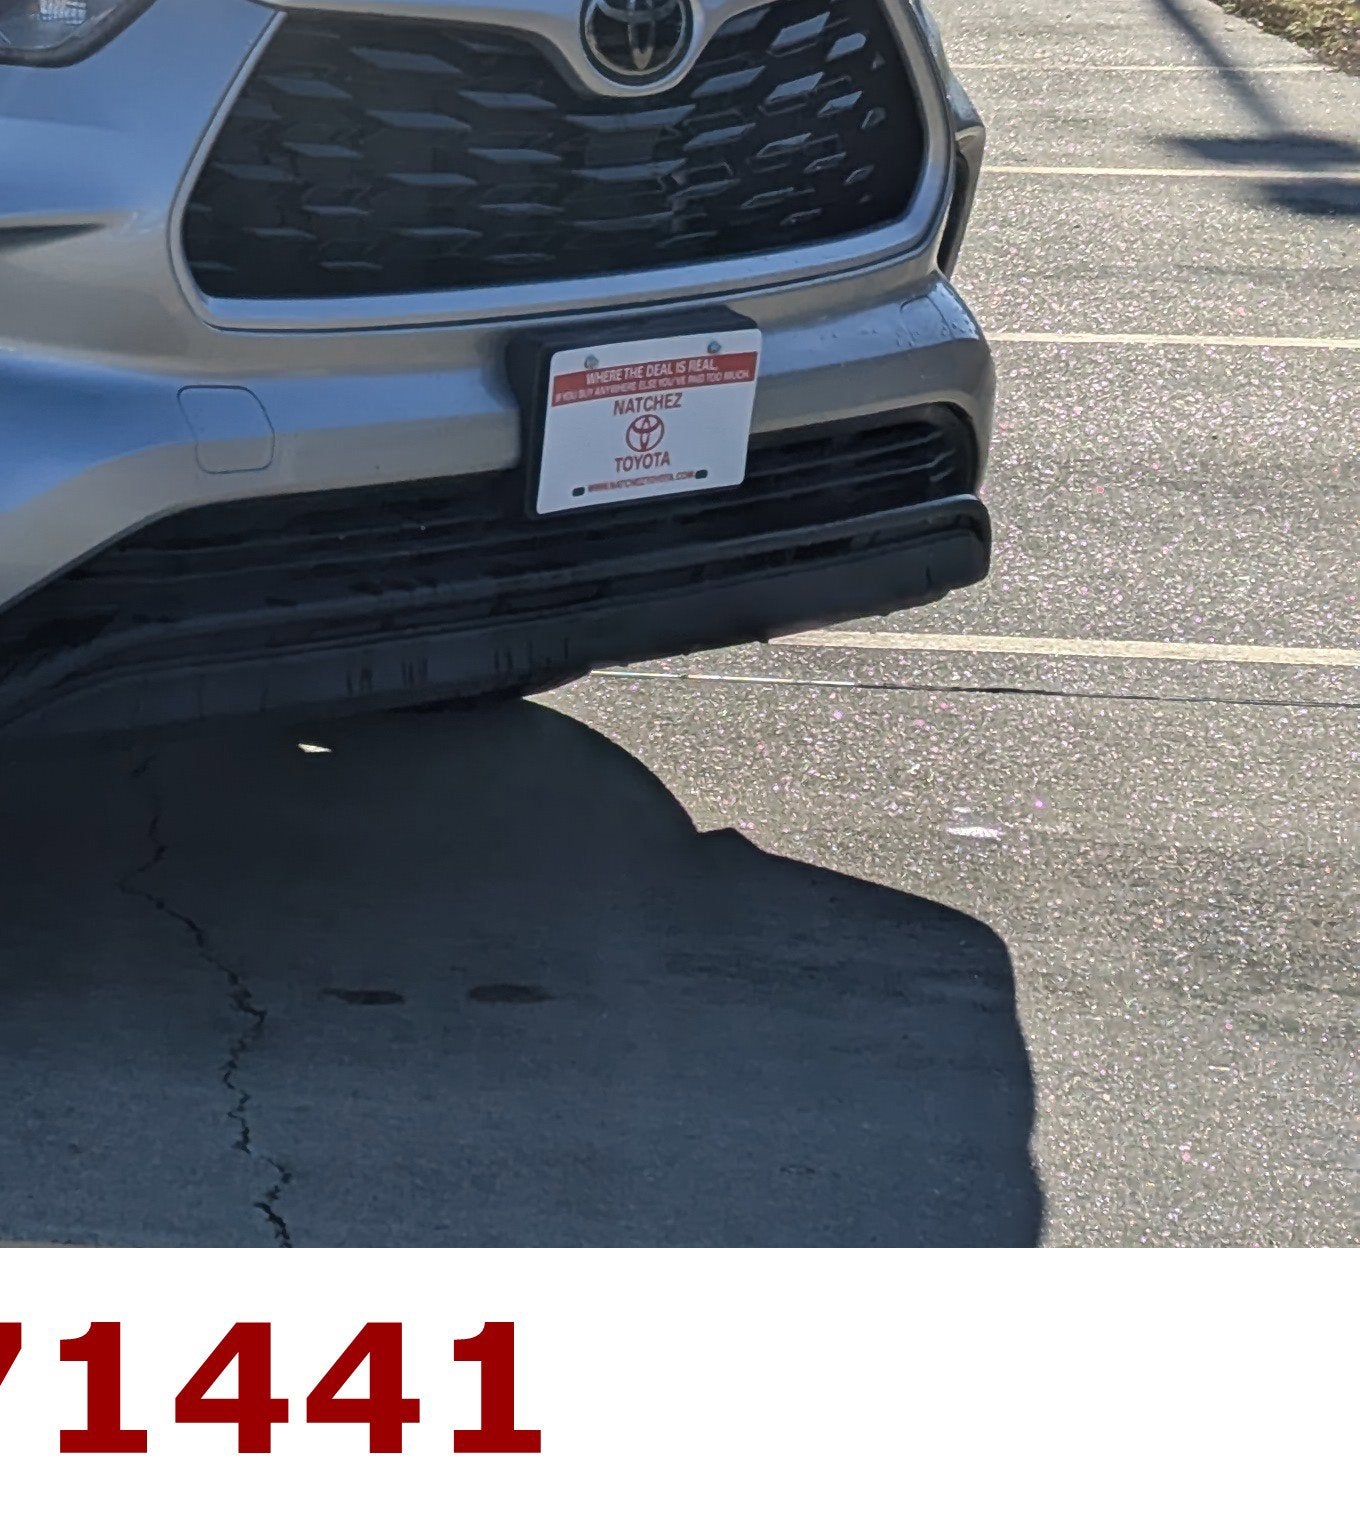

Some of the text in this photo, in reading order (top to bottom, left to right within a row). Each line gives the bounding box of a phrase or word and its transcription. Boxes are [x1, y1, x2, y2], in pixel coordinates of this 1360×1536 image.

[586, 368, 623, 384] WHERE
[624, 365, 644, 379] THE
[646, 363, 673, 377] DEAL
[675, 361, 686, 374] IS
[613, 393, 683, 415] NATCHEZ
[615, 451, 671, 473] TOYOTA
